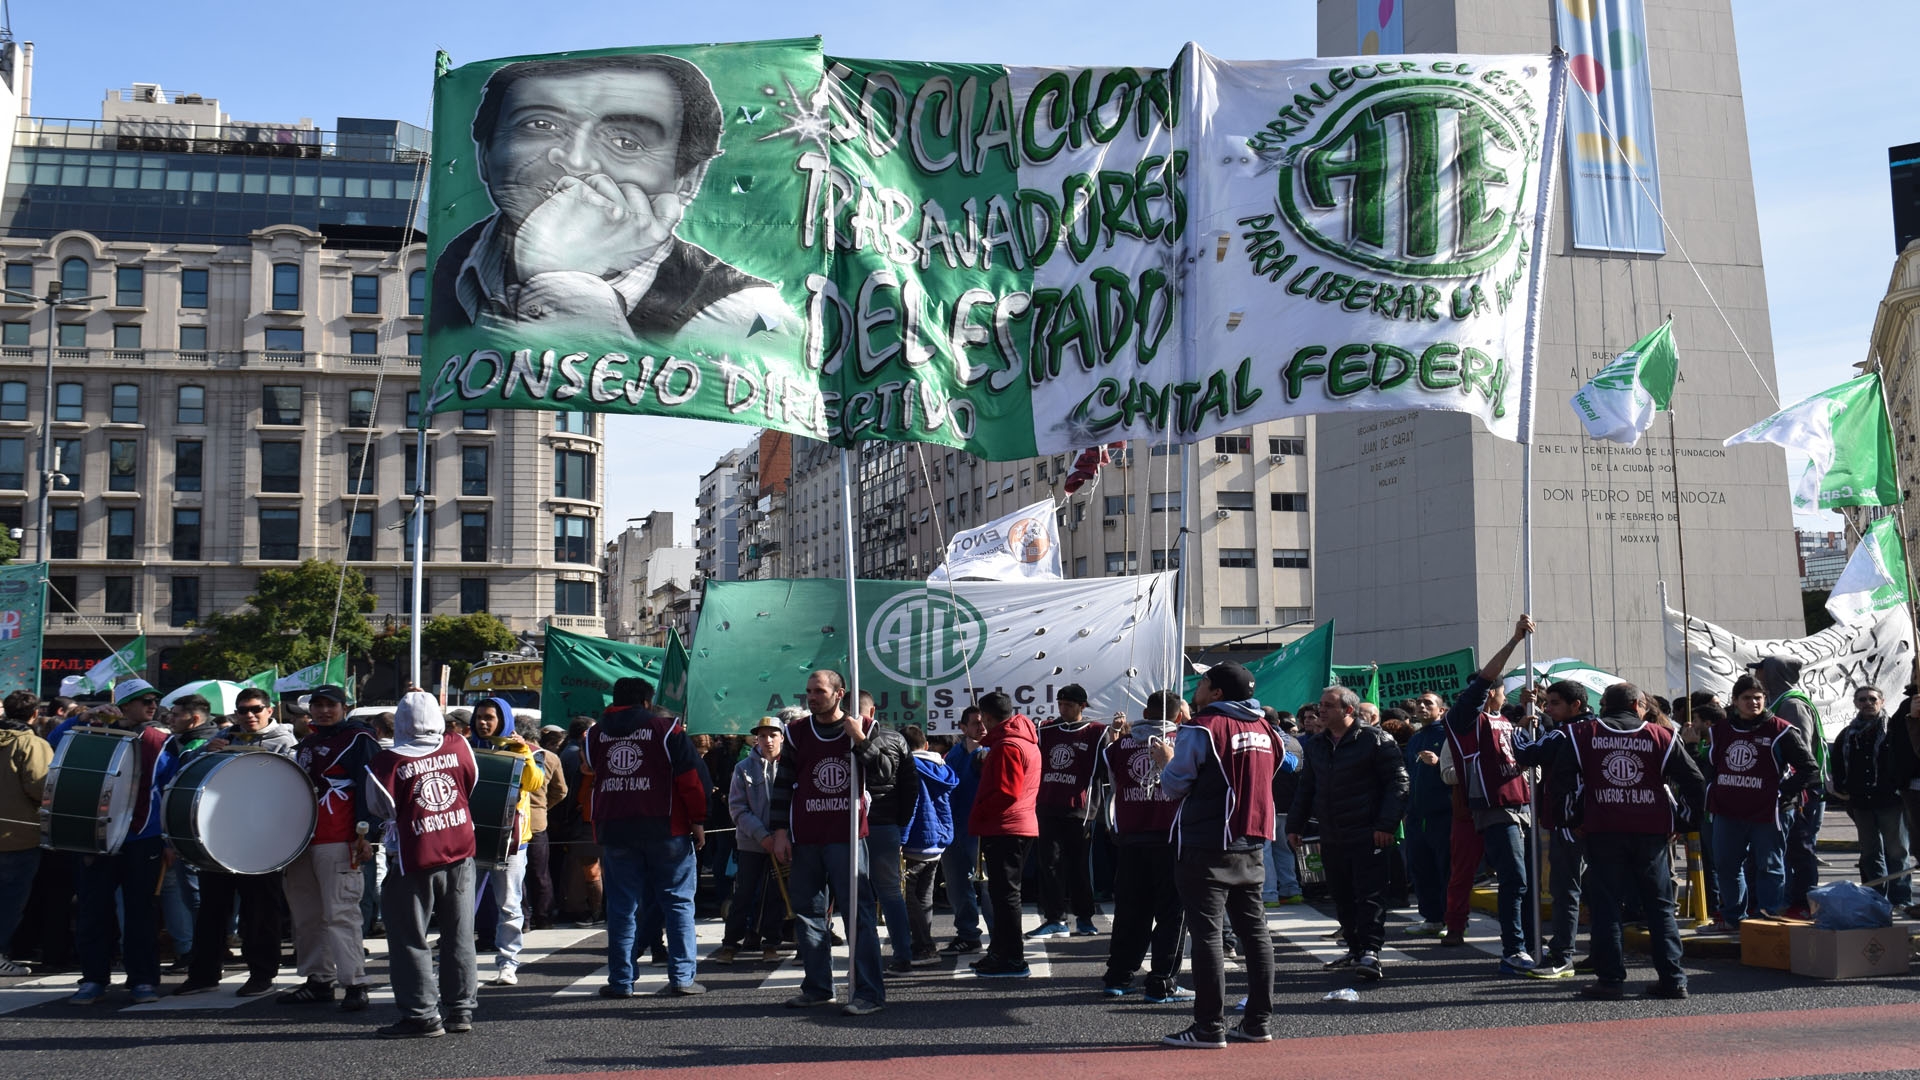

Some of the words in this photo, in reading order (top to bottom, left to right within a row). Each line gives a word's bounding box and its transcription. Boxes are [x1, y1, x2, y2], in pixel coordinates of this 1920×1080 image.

[1245, 62, 1421, 151] FORTALECER
[1430, 61, 1474, 75] EL
[1303, 91, 1517, 258] ATE
[796, 150, 1190, 272] TRABAJADORES
[1237, 213, 1298, 283] PARA
[1285, 264, 1442, 322] LIBERAR
[1450, 284, 1491, 320] LA
[804, 270, 936, 383] DEL
[948, 265, 1176, 393] ESTADO
[427, 348, 701, 413] CONSEJO
[1571, 368, 1578, 379] A
[1068, 356, 1262, 434] CAPITAL
[1282, 342, 1509, 418] FEDER
[1576, 391, 1601, 422] Federal
[1380, 415, 1407, 430] FUNDACION
[1361, 439, 1377, 456] JUAN
[1381, 436, 1389, 450] DE
[1392, 430, 1414, 447] GARAY
[1538, 444, 1551, 454] EN
[1555, 445, 1566, 454] EL
[1570, 446, 1578, 454] IV
[1583, 446, 1642, 456] CENTENARIO
[1646, 448, 1657, 457] DE
[1660, 448, 1672, 457] LA
[1675, 448, 1726, 458] FUNDACION
[1399, 456, 1406, 465] DE
[1591, 463, 1602, 472] DE
[1607, 464, 1619, 472] LA
[1623, 465, 1654, 473] CIUDAD
[1543, 488, 1574, 502] DON
[1582, 489, 1630, 503] PEDRO
[1637, 490, 1654, 503] DE
[1662, 491, 1726, 505] MENDOZA
[1605, 513, 1616, 521] DE
[1620, 513, 1664, 522] FEBRERO
[1620, 535, 1660, 544] MDXXXVI
[876, 603, 968, 680] ATE
[493, 667, 524, 686] CASA
[1396, 664, 1457, 682] HISTORIA
[1389, 677, 1460, 697] ESPECULEN
[875, 684, 1054, 711] JUSTCI
[929, 710, 954, 720] DE
[1591, 736, 1653, 753] ORGANIZACION
[397, 753, 459, 780] ORGANIZACION
[624, 778, 630, 791] Y
[1717, 774, 1763, 789] ORGANIZACION
[1602, 788, 1624, 803] VERDE
[1625, 789, 1631, 804] Y
[1632, 788, 1656, 804] BLANCA
